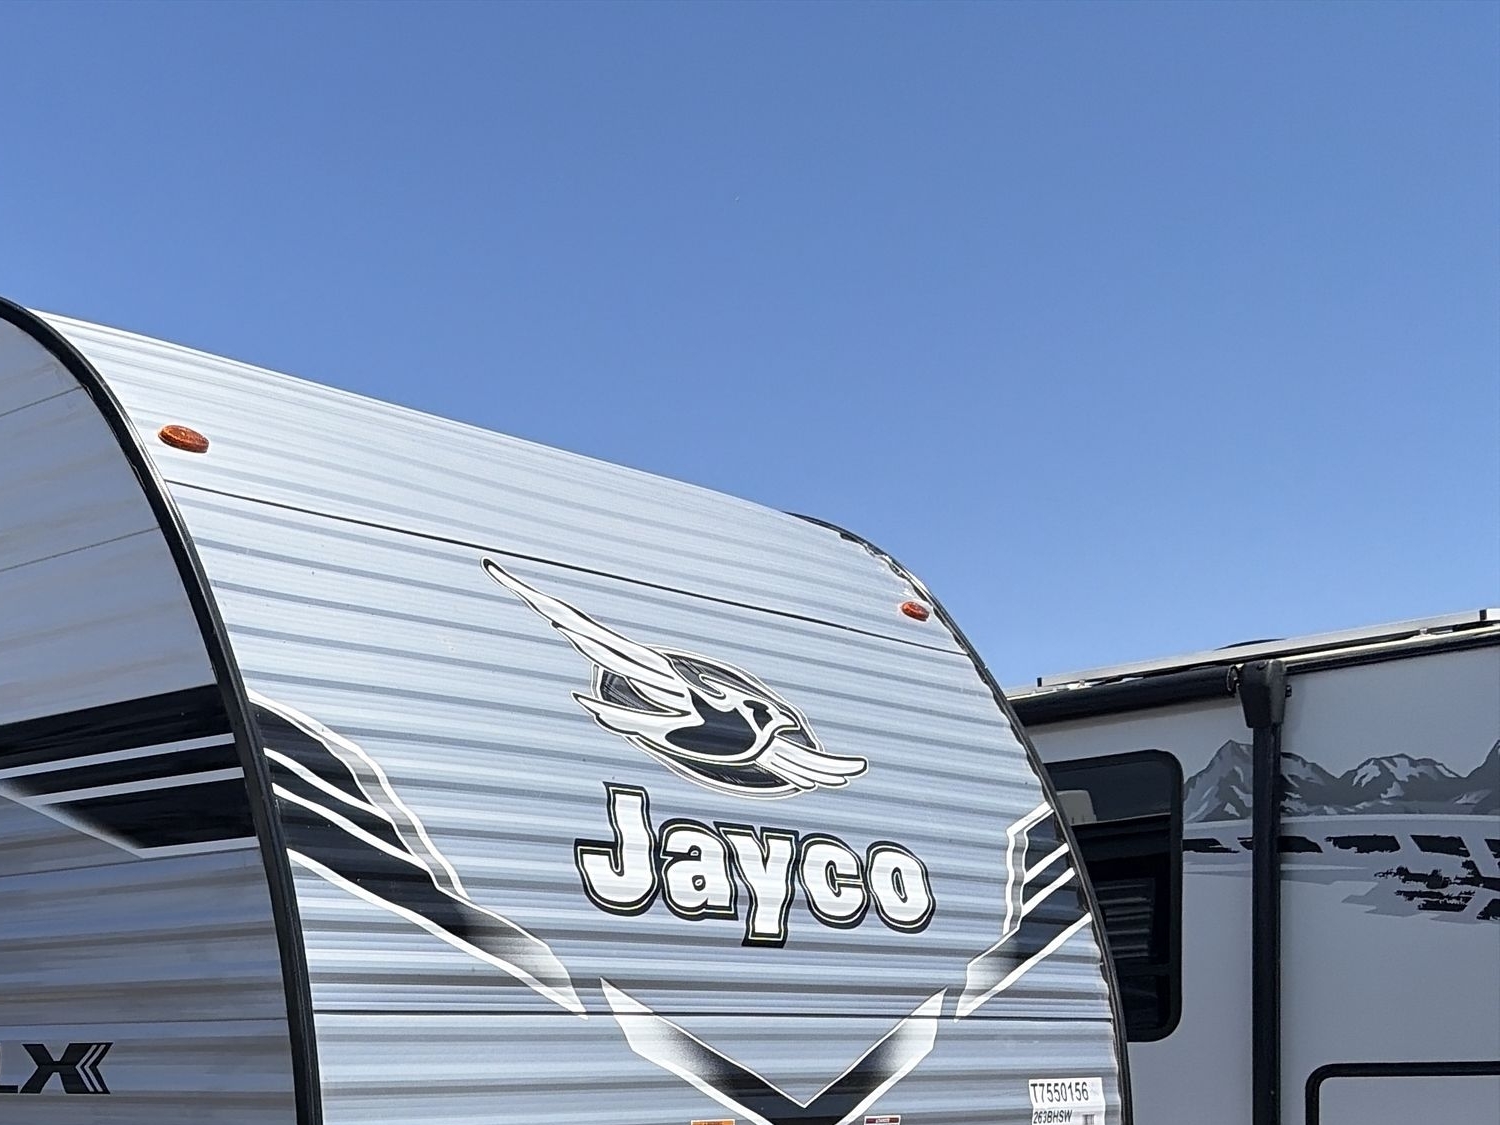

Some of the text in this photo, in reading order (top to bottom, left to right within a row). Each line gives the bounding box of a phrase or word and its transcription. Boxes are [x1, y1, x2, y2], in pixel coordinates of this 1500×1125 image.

[575, 782, 936, 948] Jayco
[1030, 1081, 1089, 1103] T7550156
[1033, 1110, 1073, 1124] 263BHSW
